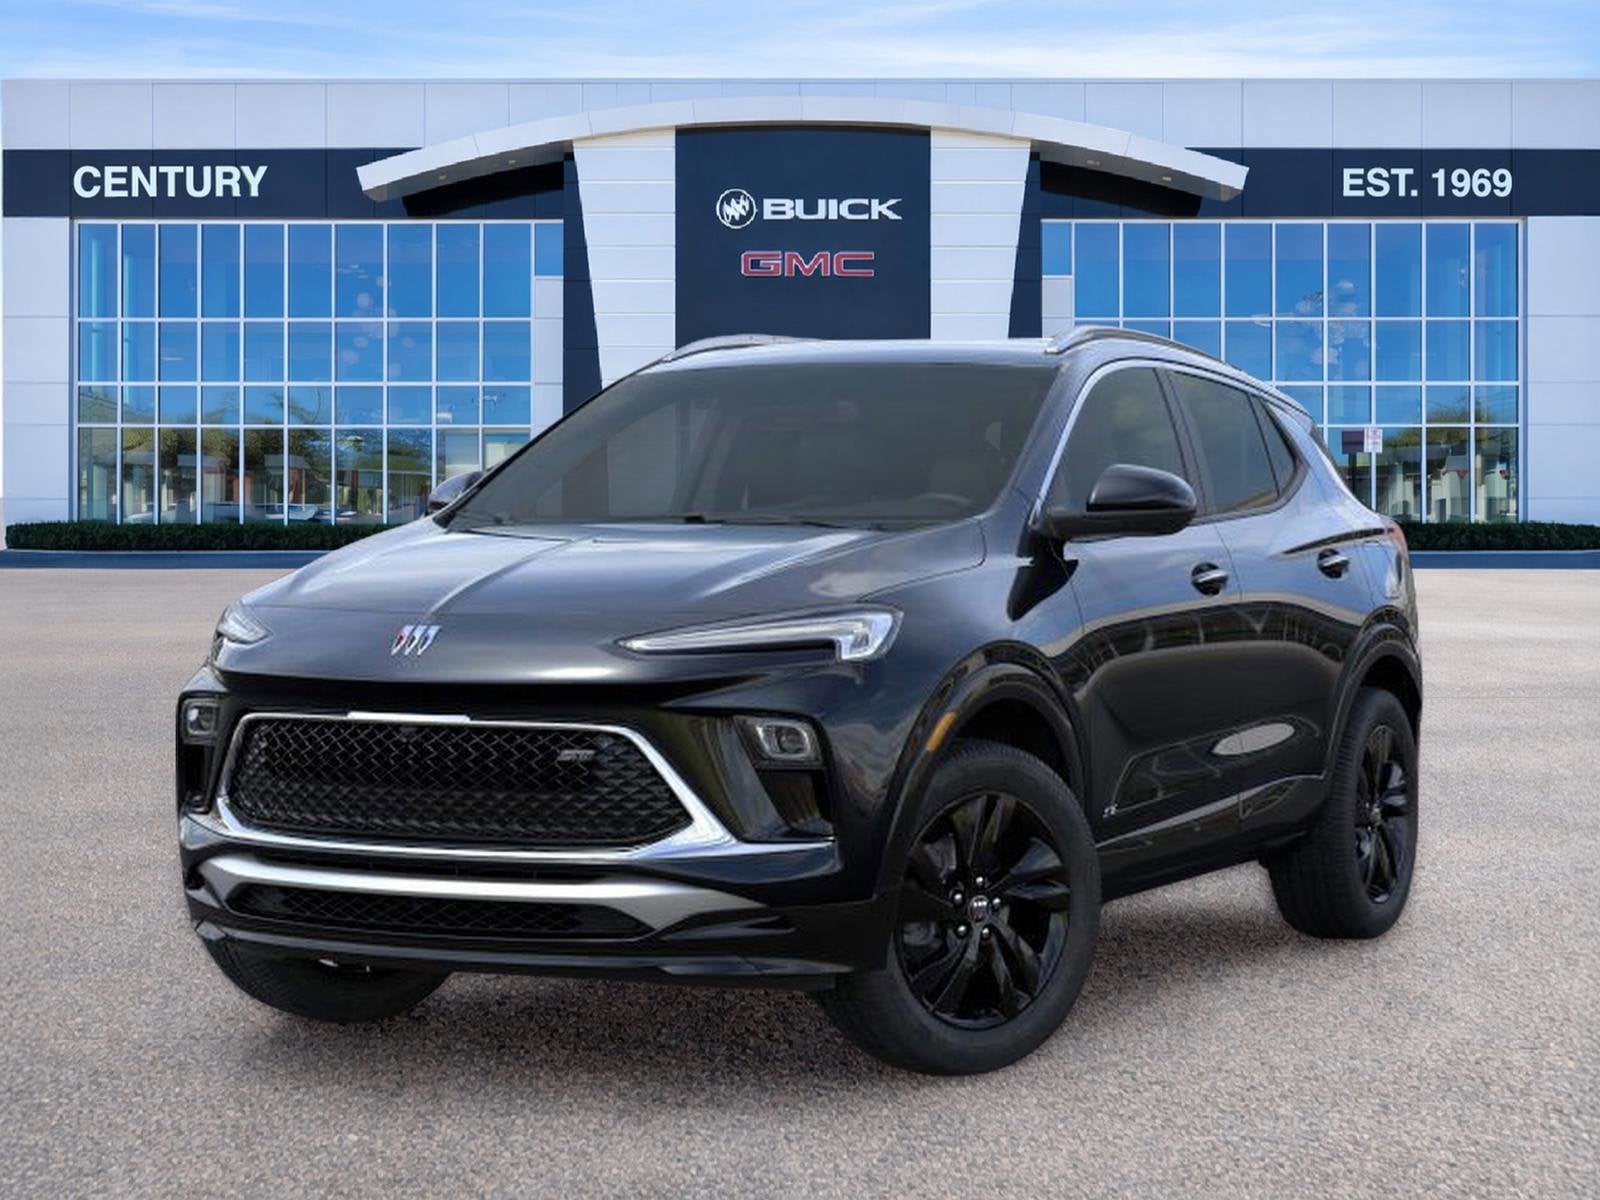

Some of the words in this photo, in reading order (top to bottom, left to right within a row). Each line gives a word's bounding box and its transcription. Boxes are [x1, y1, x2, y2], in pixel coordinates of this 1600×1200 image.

[73, 165, 268, 199] CENTURY
[1342, 168, 1418, 198] EST.
[1433, 168, 1513, 198] 1969
[762, 198, 903, 220] BUICK
[740, 250, 876, 278] GMC
